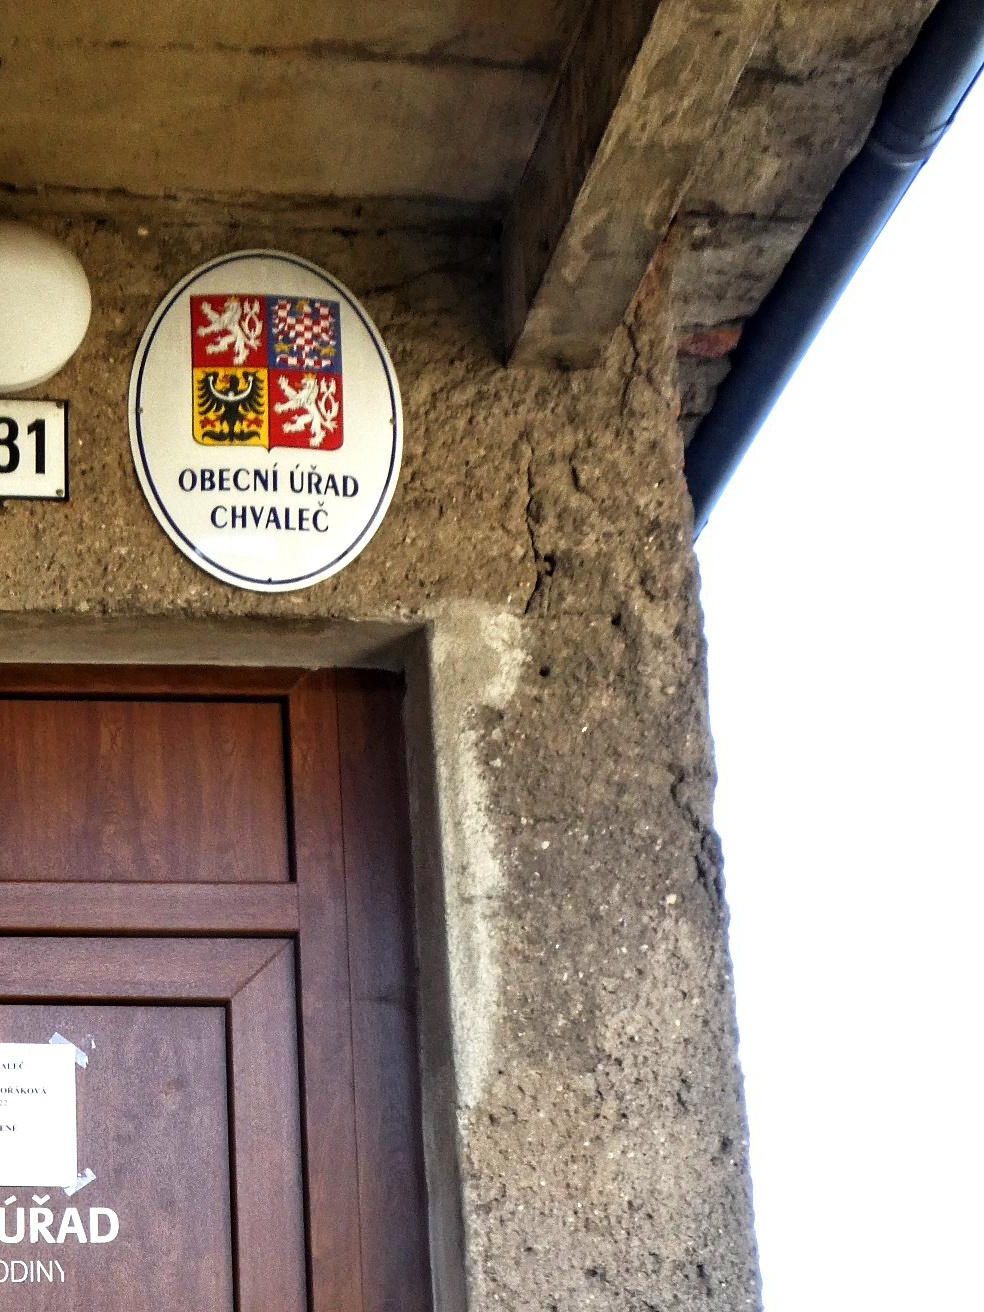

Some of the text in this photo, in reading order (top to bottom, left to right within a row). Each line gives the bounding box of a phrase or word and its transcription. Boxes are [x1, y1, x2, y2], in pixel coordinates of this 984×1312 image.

[178, 462, 359, 498] OBECNÍ ÚŘAD
[210, 500, 330, 533] CHVALEČ
